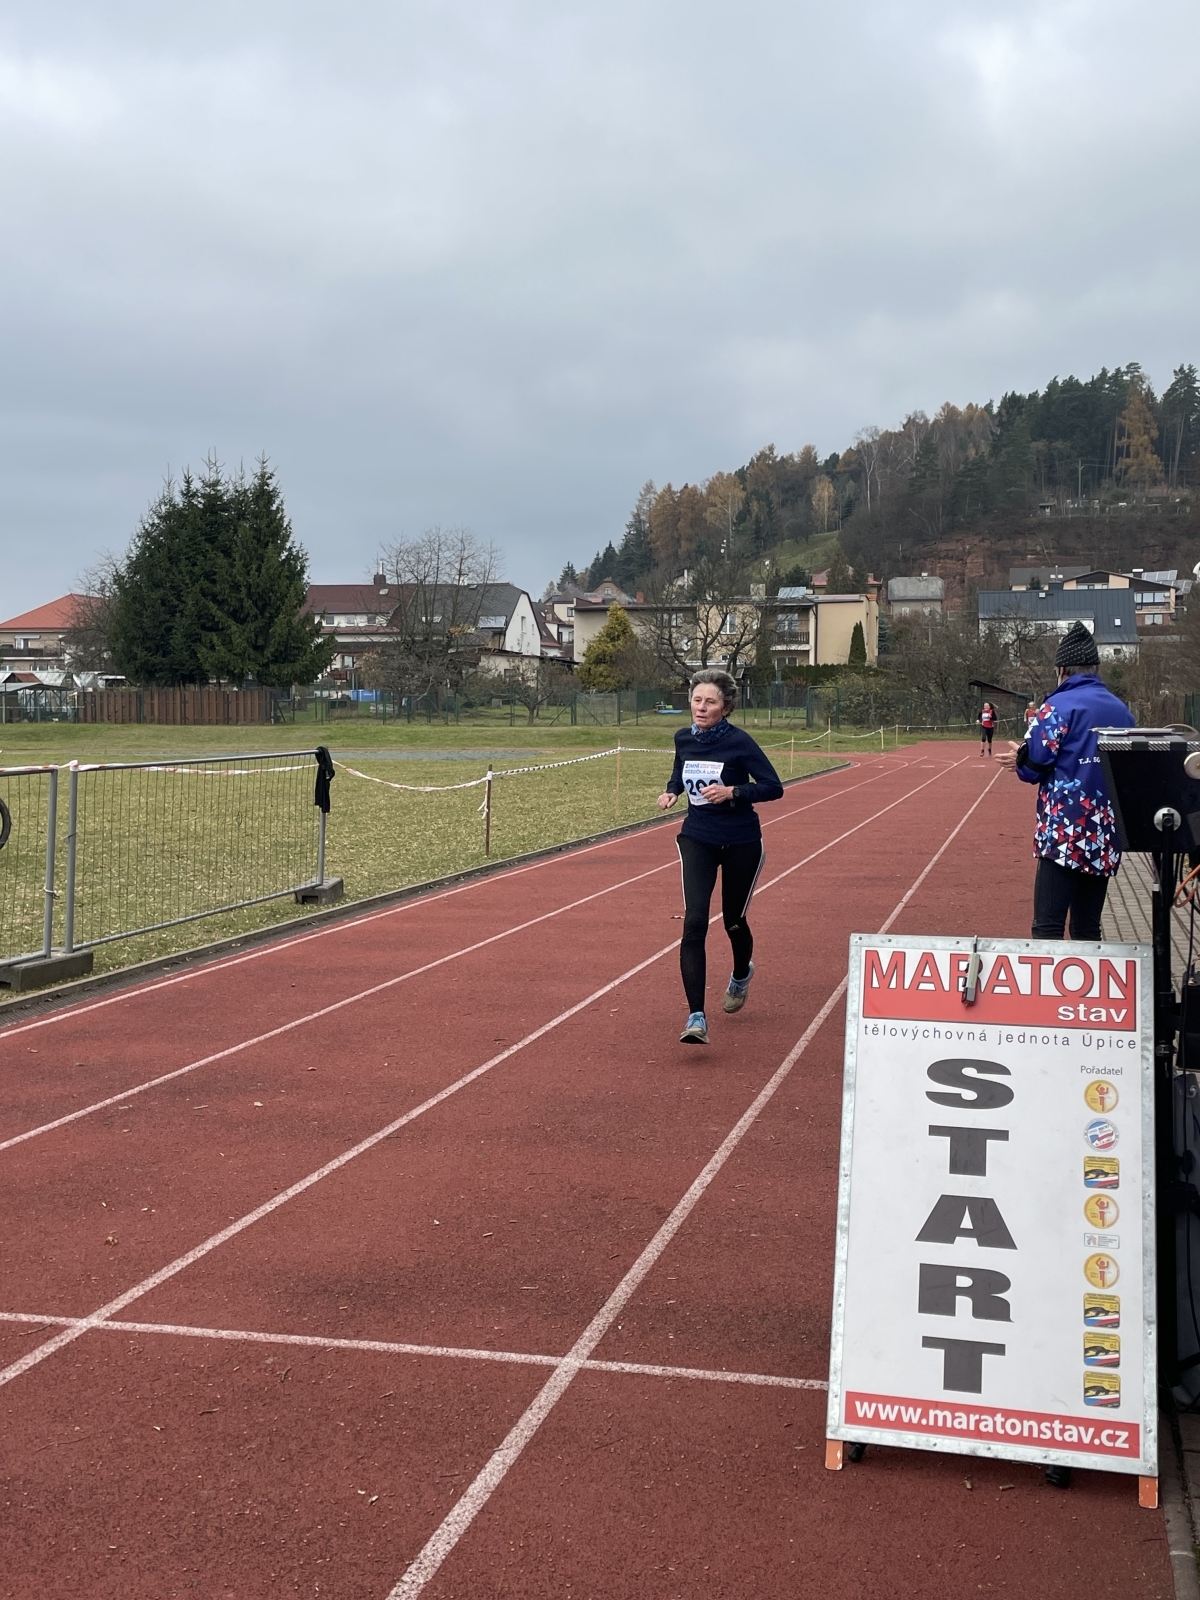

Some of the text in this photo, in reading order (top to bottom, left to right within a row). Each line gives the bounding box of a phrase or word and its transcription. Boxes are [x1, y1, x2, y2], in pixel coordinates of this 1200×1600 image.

[864, 949, 1137, 1000] MARATON
[1057, 1003, 1128, 1023] stav
[864, 1024, 1137, 1050] tělovýchovná jednota Úpice
[1080, 1065, 1123, 1076] Pořadatel
[915, 1058, 1018, 1394] START
[855, 1400, 1130, 1450] www.maratonstav.cz
